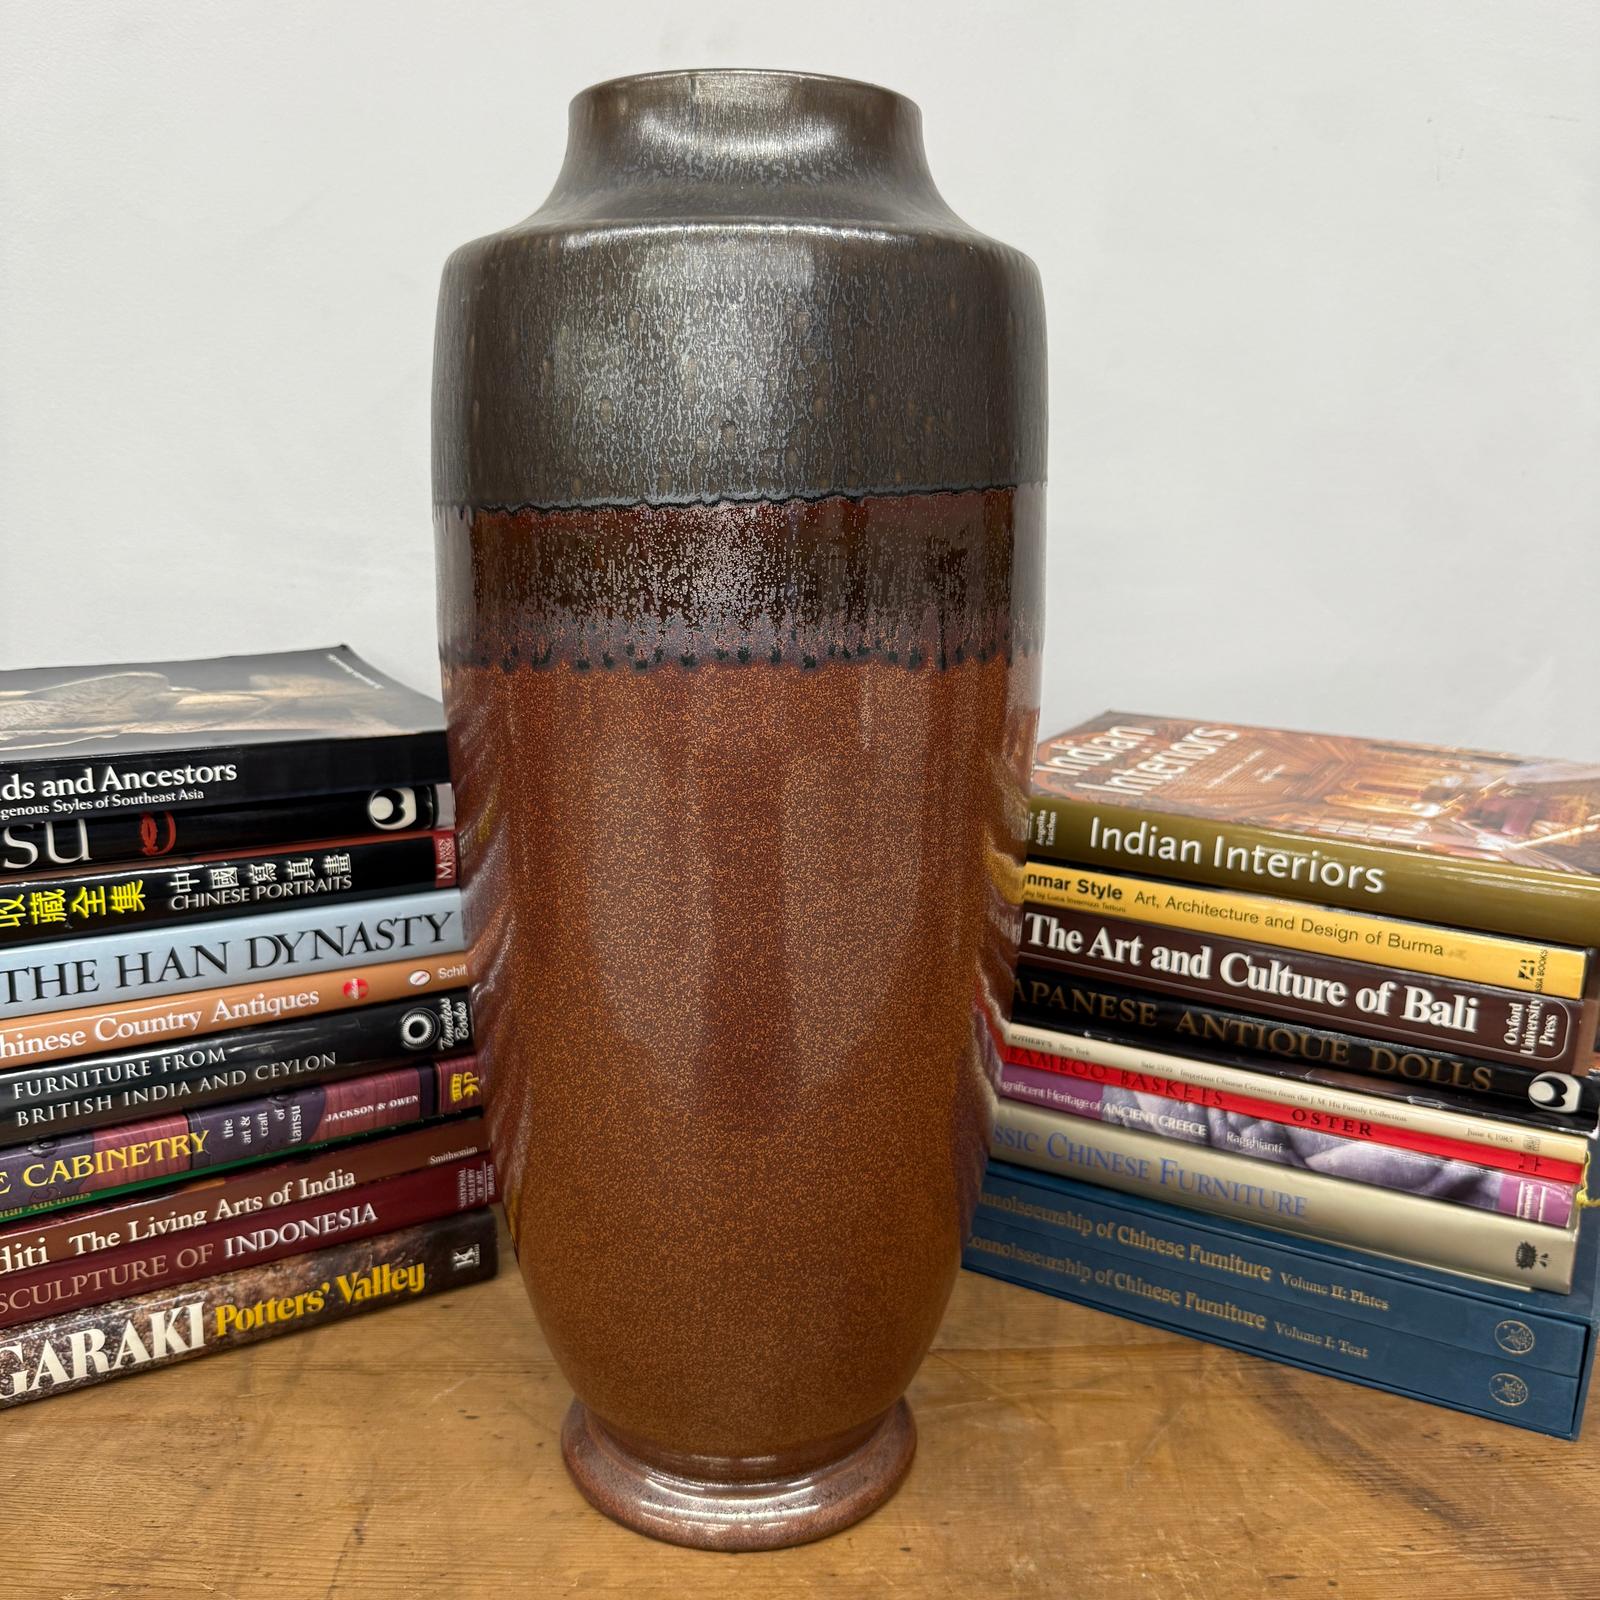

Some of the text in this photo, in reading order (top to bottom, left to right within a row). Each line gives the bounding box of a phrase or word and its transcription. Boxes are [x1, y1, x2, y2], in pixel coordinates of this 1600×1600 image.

[42, 767, 96, 796] and
[101, 763, 238, 791] Ancestors
[53, 799, 93, 814] Styles
[96, 795, 110, 809] of
[112, 791, 176, 806] Southeast
[179, 789, 204, 801] Asia
[1090, 816, 1202, 864] Indian
[1214, 835, 1386, 893] Interiors
[171, 875, 352, 910] CHINESE PORTRAITS
[1077, 879, 1123, 901] Style
[1134, 891, 1160, 909] Art,
[1165, 896, 1259, 924] Architecture
[1265, 916, 1295, 930] and
[1301, 919, 1359, 942] Design
[1365, 931, 1383, 945] of
[1388, 932, 1444, 955] Burma
[0, 911, 457, 1004] THE HAN DYNASTY
[438, 964, 468, 979] Schif
[1025, 912, 1481, 1033] The Art and Culture of Bali
[95, 1010, 201, 1042] Country
[212, 990, 319, 1024] Antiques
[438, 997, 454, 1050] Timeless
[454, 1001, 469, 1041] Books
[1504, 1003, 1523, 1045] Oxford
[1520, 998, 1543, 1054] University
[1539, 1014, 1557, 1046] Press
[13, 1048, 227, 1100] FURNITURE FROM
[1008, 1047, 1224, 1105] BAMBOO BASKETS
[1176, 1010, 1349, 1064] ANTIQUE
[1370, 1046, 1493, 1091] DOLLS
[17, 1052, 336, 1127] BRITISH INDIA AND CEYLON
[324, 1095, 419, 1122] JACKSON & OWEN
[1047, 1088, 1088, 1110] Heritage
[1089, 1100, 1101, 1111] of
[1103, 1103, 1156, 1124] ANCIENT
[1158, 1115, 1207, 1136] GREECE
[222, 1118, 233, 1140] the
[240, 1115, 251, 1127] &
[1291, 1109, 1373, 1136] OSTER
[23, 1130, 209, 1187] CABINETRY
[429, 1146, 478, 1165] Smithsonian
[69, 1231, 120, 1256] The
[128, 1211, 207, 1242] Living
[213, 1195, 263, 1221] Arts
[270, 1181, 293, 1206] of
[300, 1168, 356, 1197] India
[0, 1203, 378, 1314] SCULPTURE OF INDONESIA
[1096, 1222, 1115, 1239] of
[1117, 1226, 1185, 1259] Chinese
[1189, 1243, 1272, 1281] Furniture
[1280, 1272, 1328, 1295] Volume
[1350, 1289, 1389, 1311] Plates
[0, 1301, 206, 1400] GARAKI
[336, 1262, 425, 1304] Valley
[1094, 1268, 1115, 1286] of
[1114, 1272, 1180, 1304] Chinese
[1185, 1291, 1267, 1330] Furniture
[1274, 1321, 1322, 1345] Volume
[1337, 1338, 1369, 1359] Text
